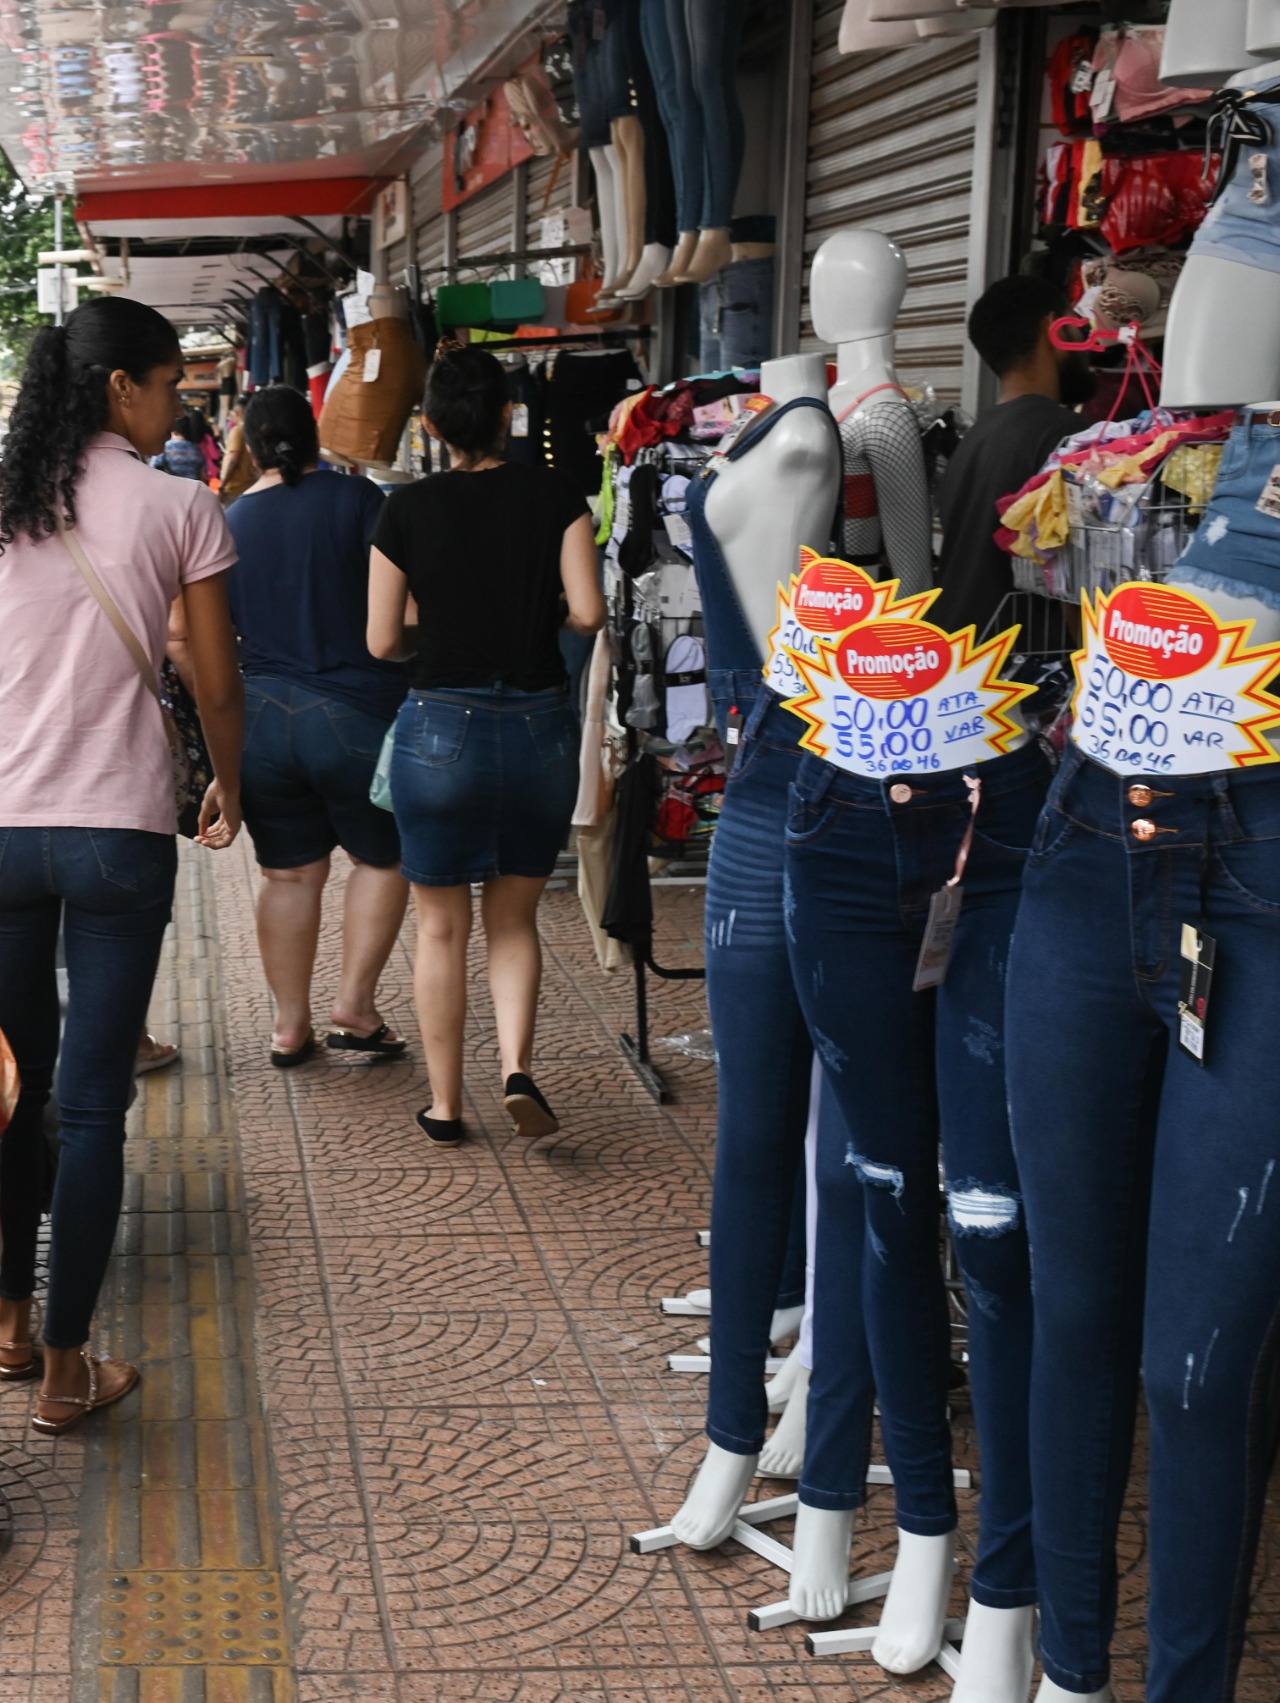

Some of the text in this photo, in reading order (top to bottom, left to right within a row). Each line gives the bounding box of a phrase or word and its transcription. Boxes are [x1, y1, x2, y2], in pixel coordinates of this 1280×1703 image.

[798, 583, 863, 615] Promoção
[1109, 611, 1203, 659] Promoção
[846, 646, 940, 679] Promoção
[1088, 654, 1235, 716] 50,00 ATA
[830, 691, 979, 732] 50,00 ATA
[1081, 691, 1168, 747] 55,00
[835, 716, 986, 760] 55,00 VAR
[865, 760, 887, 773] 36
[916, 752, 941, 770] 46
